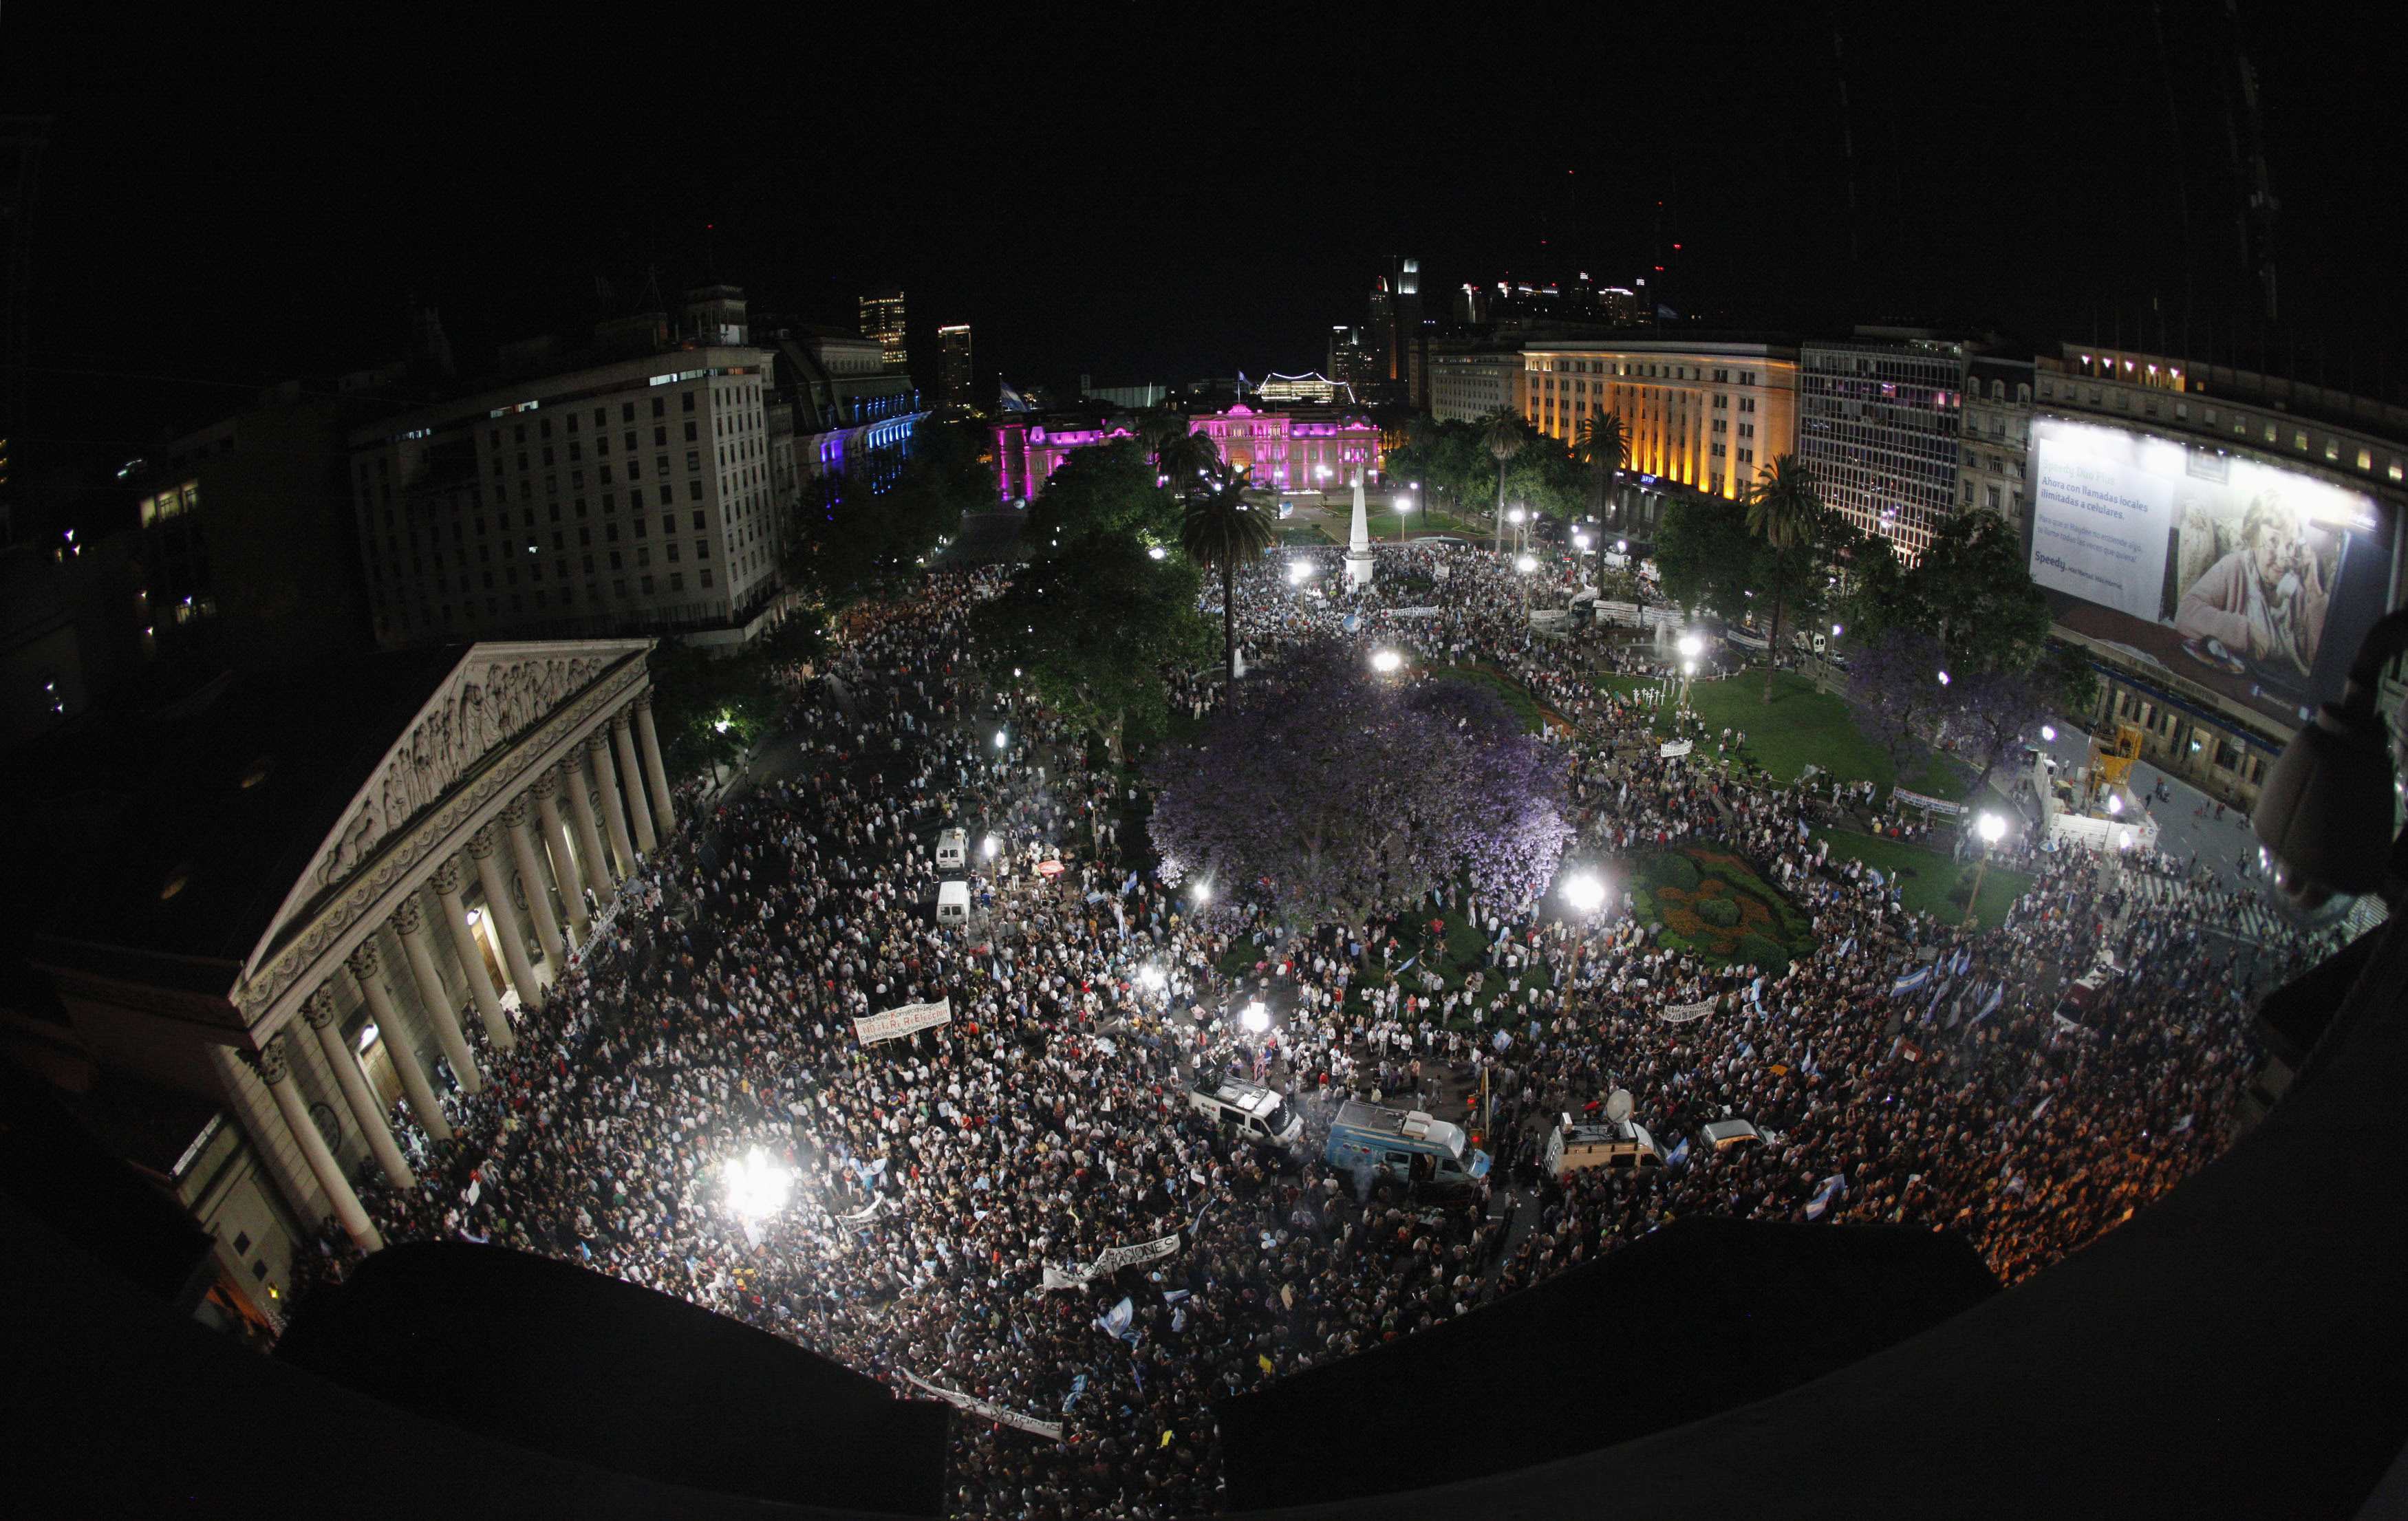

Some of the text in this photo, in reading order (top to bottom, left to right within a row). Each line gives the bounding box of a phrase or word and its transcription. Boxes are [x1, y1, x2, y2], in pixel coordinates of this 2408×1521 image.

[2041, 476, 2148, 513] Ahora con llamadas locales
[2041, 488, 2079, 507] ilimitadas
